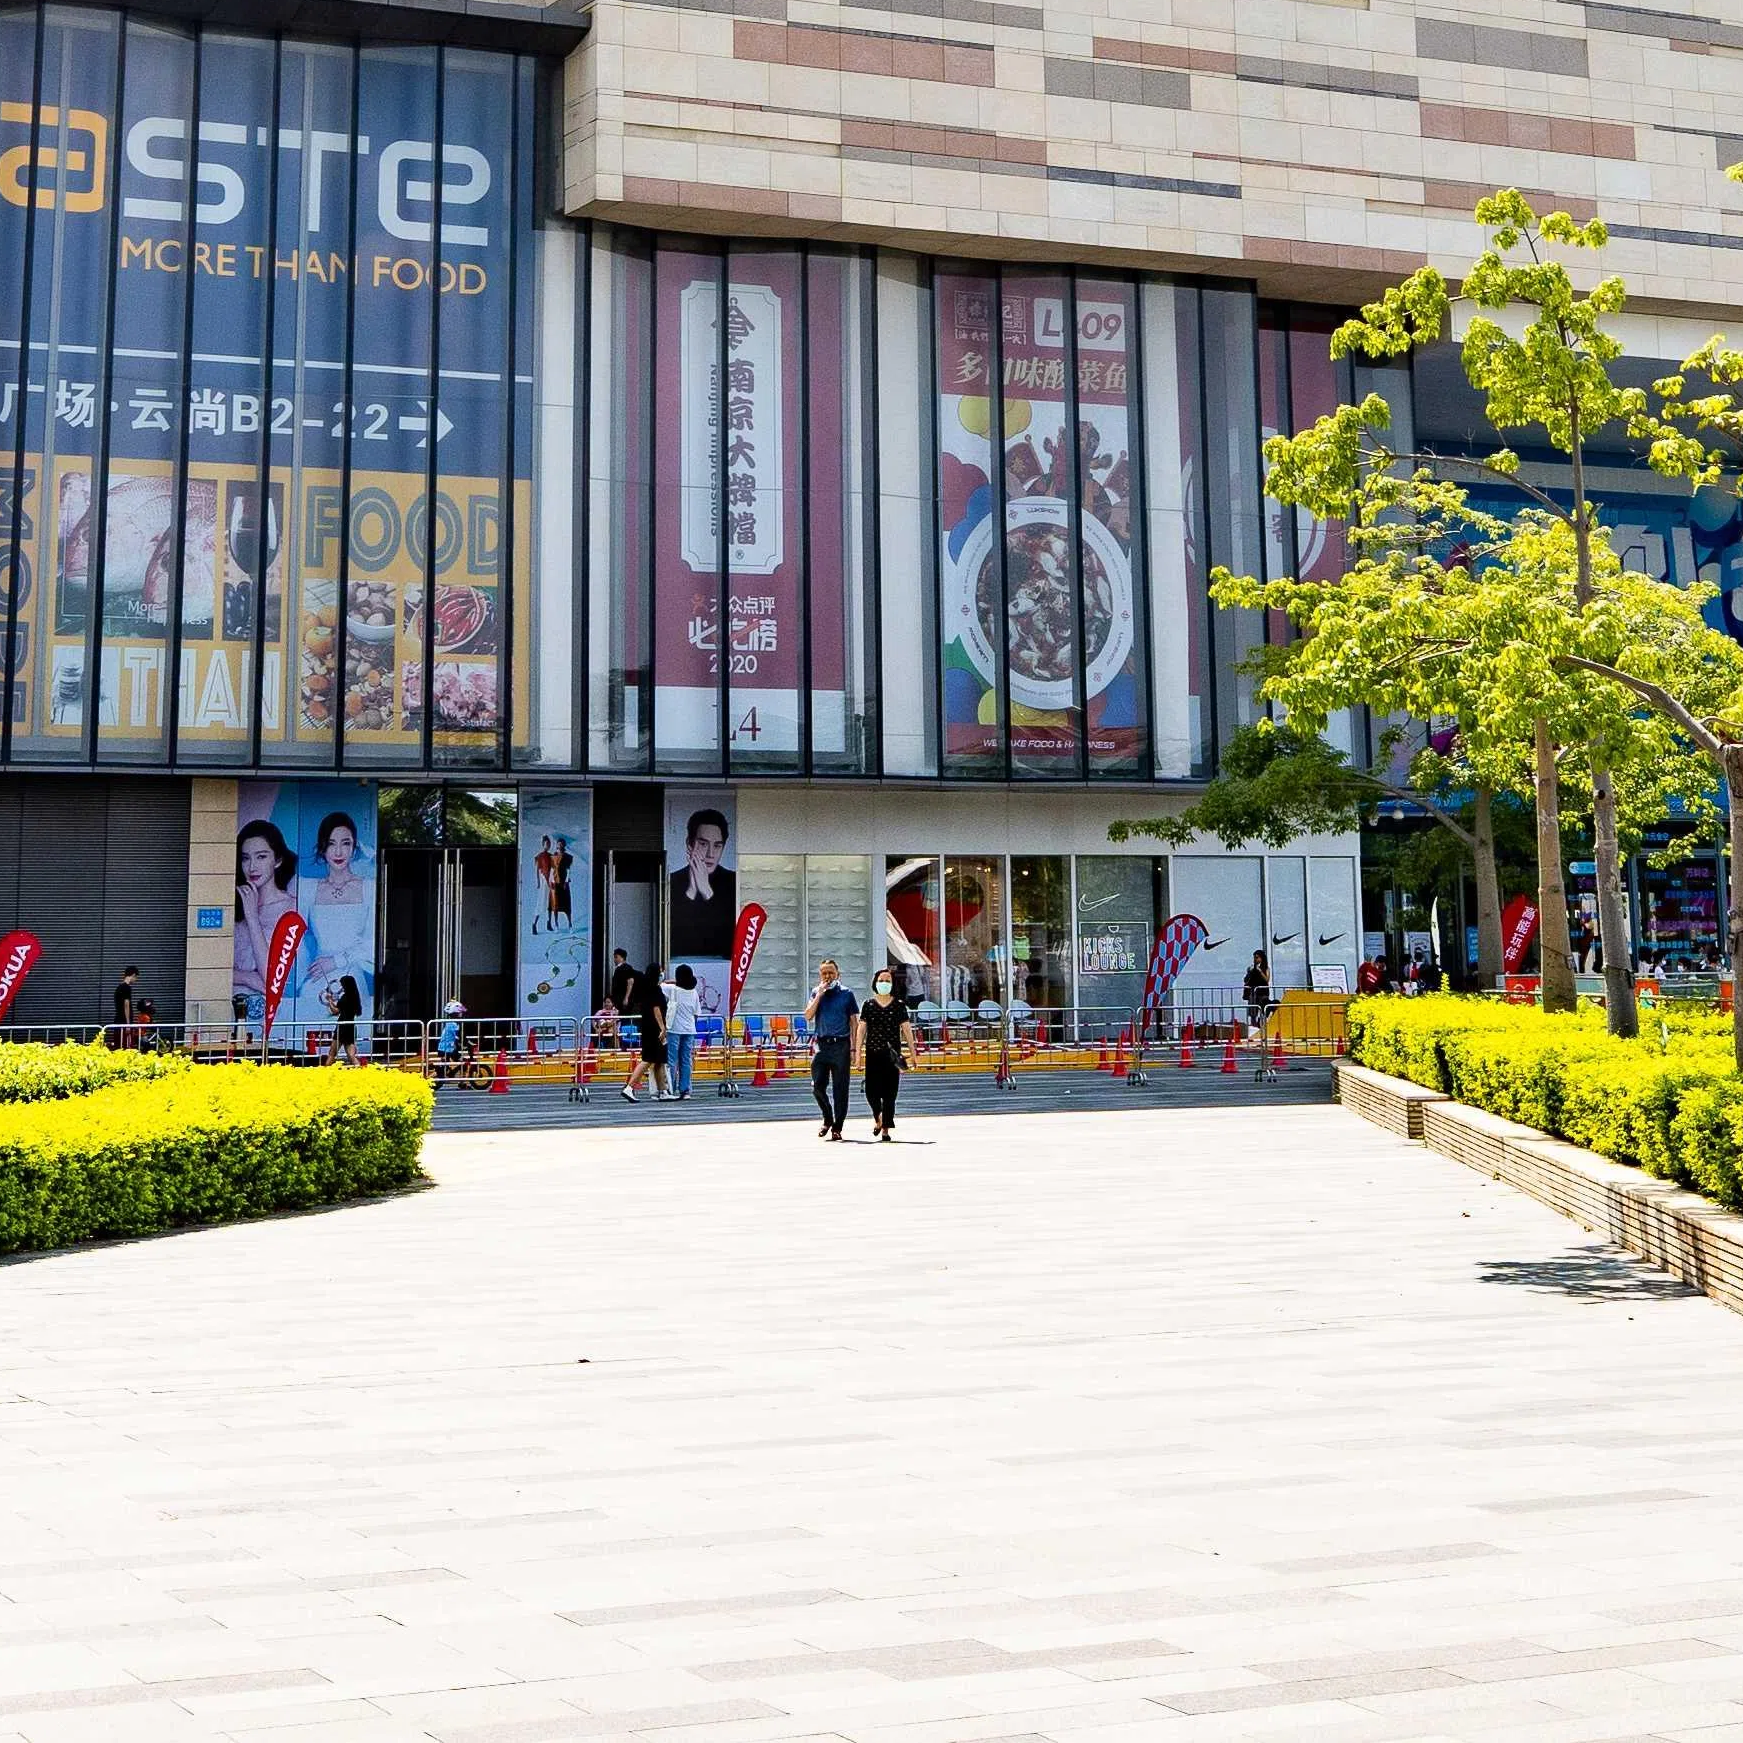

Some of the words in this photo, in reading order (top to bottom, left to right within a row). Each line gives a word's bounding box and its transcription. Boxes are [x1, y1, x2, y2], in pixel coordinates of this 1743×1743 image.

[122, 237, 237, 278] MORE
[244, 246, 358, 284] THAN
[373, 255, 488, 295] FOOD
[1042, 308, 1123, 341] L09
[304, 485, 508, 576] FOOD
[122, 646, 281, 730] THAN
[709, 654, 758, 674] 220
[271, 923, 300, 994] KOKUA
[735, 915, 761, 982] KOKUA
[1083, 937, 1123, 955] KICKS
[1083, 953, 1136, 971] LOUNGE
